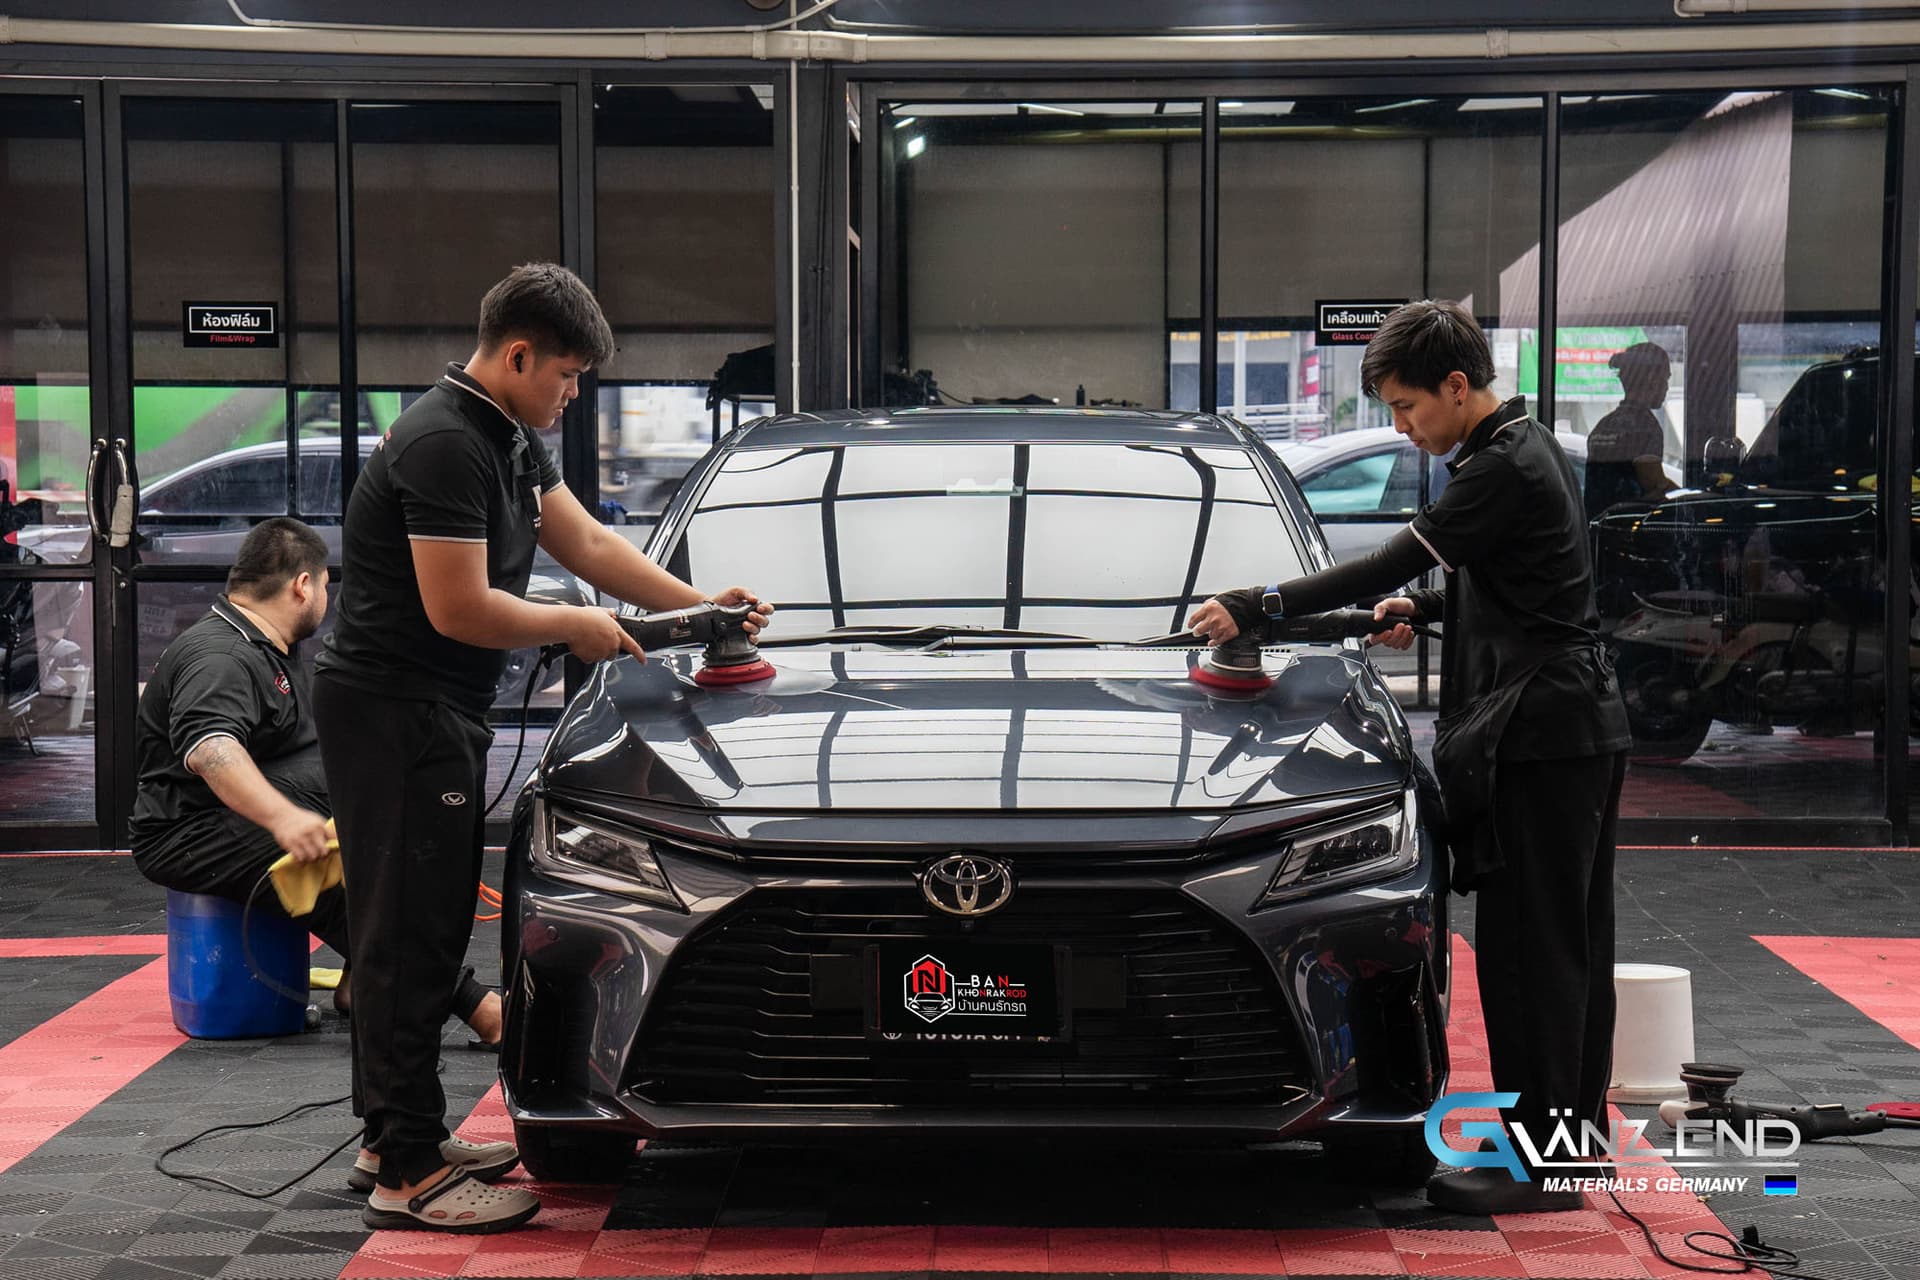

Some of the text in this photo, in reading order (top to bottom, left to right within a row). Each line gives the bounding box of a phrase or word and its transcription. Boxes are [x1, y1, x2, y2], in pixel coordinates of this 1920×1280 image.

[202, 312, 260, 327] ห้องฟิล์ม
[210, 334, 256, 344] Film&Wrap
[1331, 332, 1353, 341] Glass
[971, 974, 1009, 988] BAN
[957, 988, 1027, 998] KHONRAKROD
[957, 999, 1027, 1012] บ้านคนรักรถ
